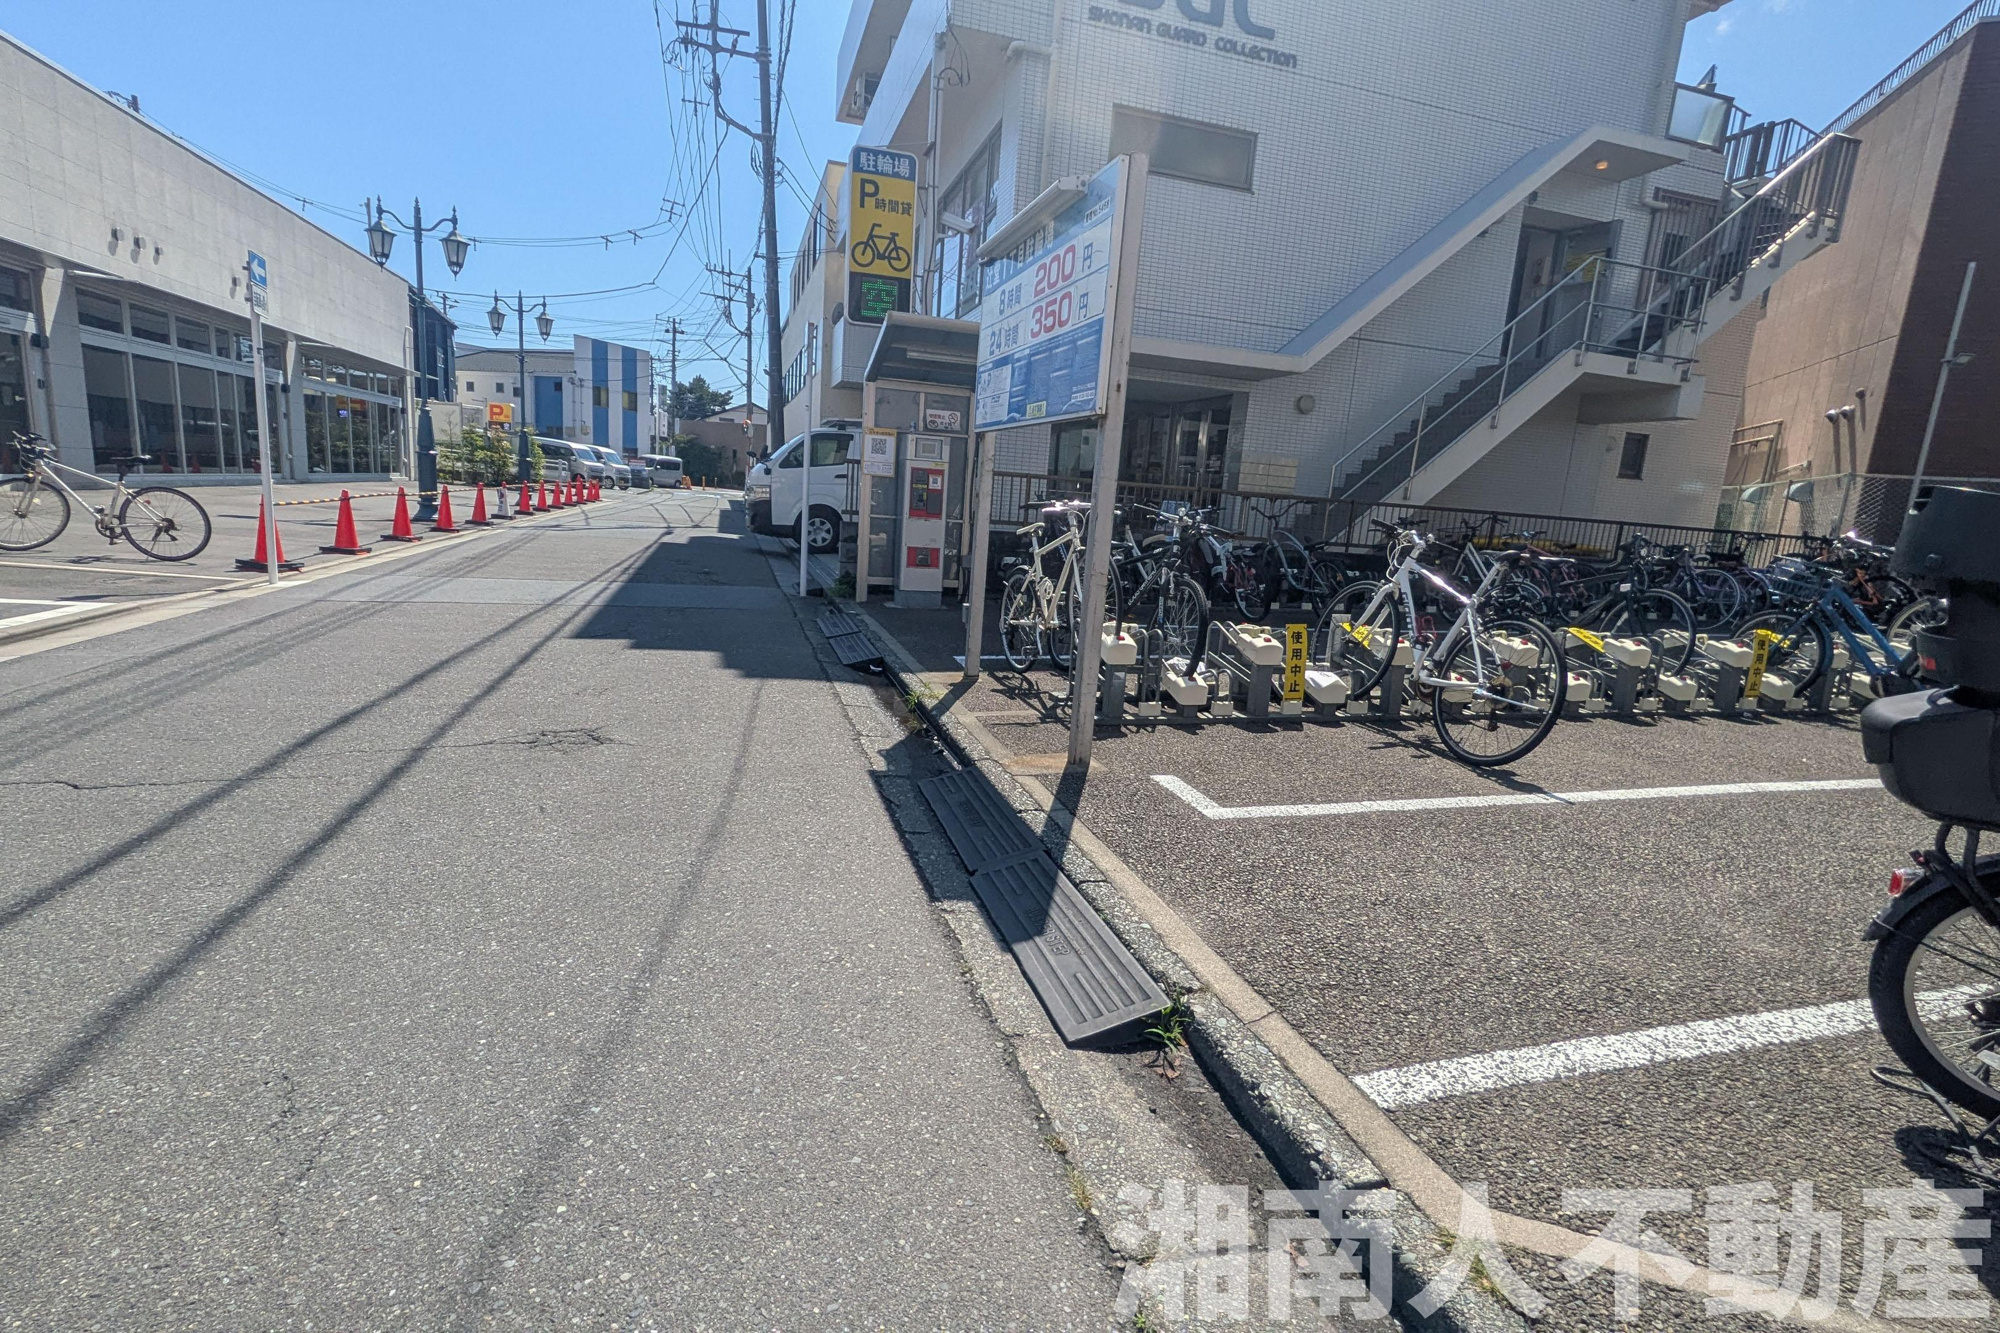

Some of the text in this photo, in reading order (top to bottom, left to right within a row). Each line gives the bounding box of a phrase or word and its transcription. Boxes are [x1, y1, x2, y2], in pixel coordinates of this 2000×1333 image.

[1155, 22, 1208, 47] GUARD
[1213, 36, 1298, 69] COLLECTION
[859, 151, 910, 178] 駐輪場
[859, 178, 912, 216] P 時間貸
[1033, 243, 1076, 298] 200
[861, 279, 897, 317] 空
[1030, 291, 1073, 339] 350
[489, 404, 504, 421] P
[1288, 630, 1303, 693] 使用中止
[1748, 639, 1766, 692] 使用中止
